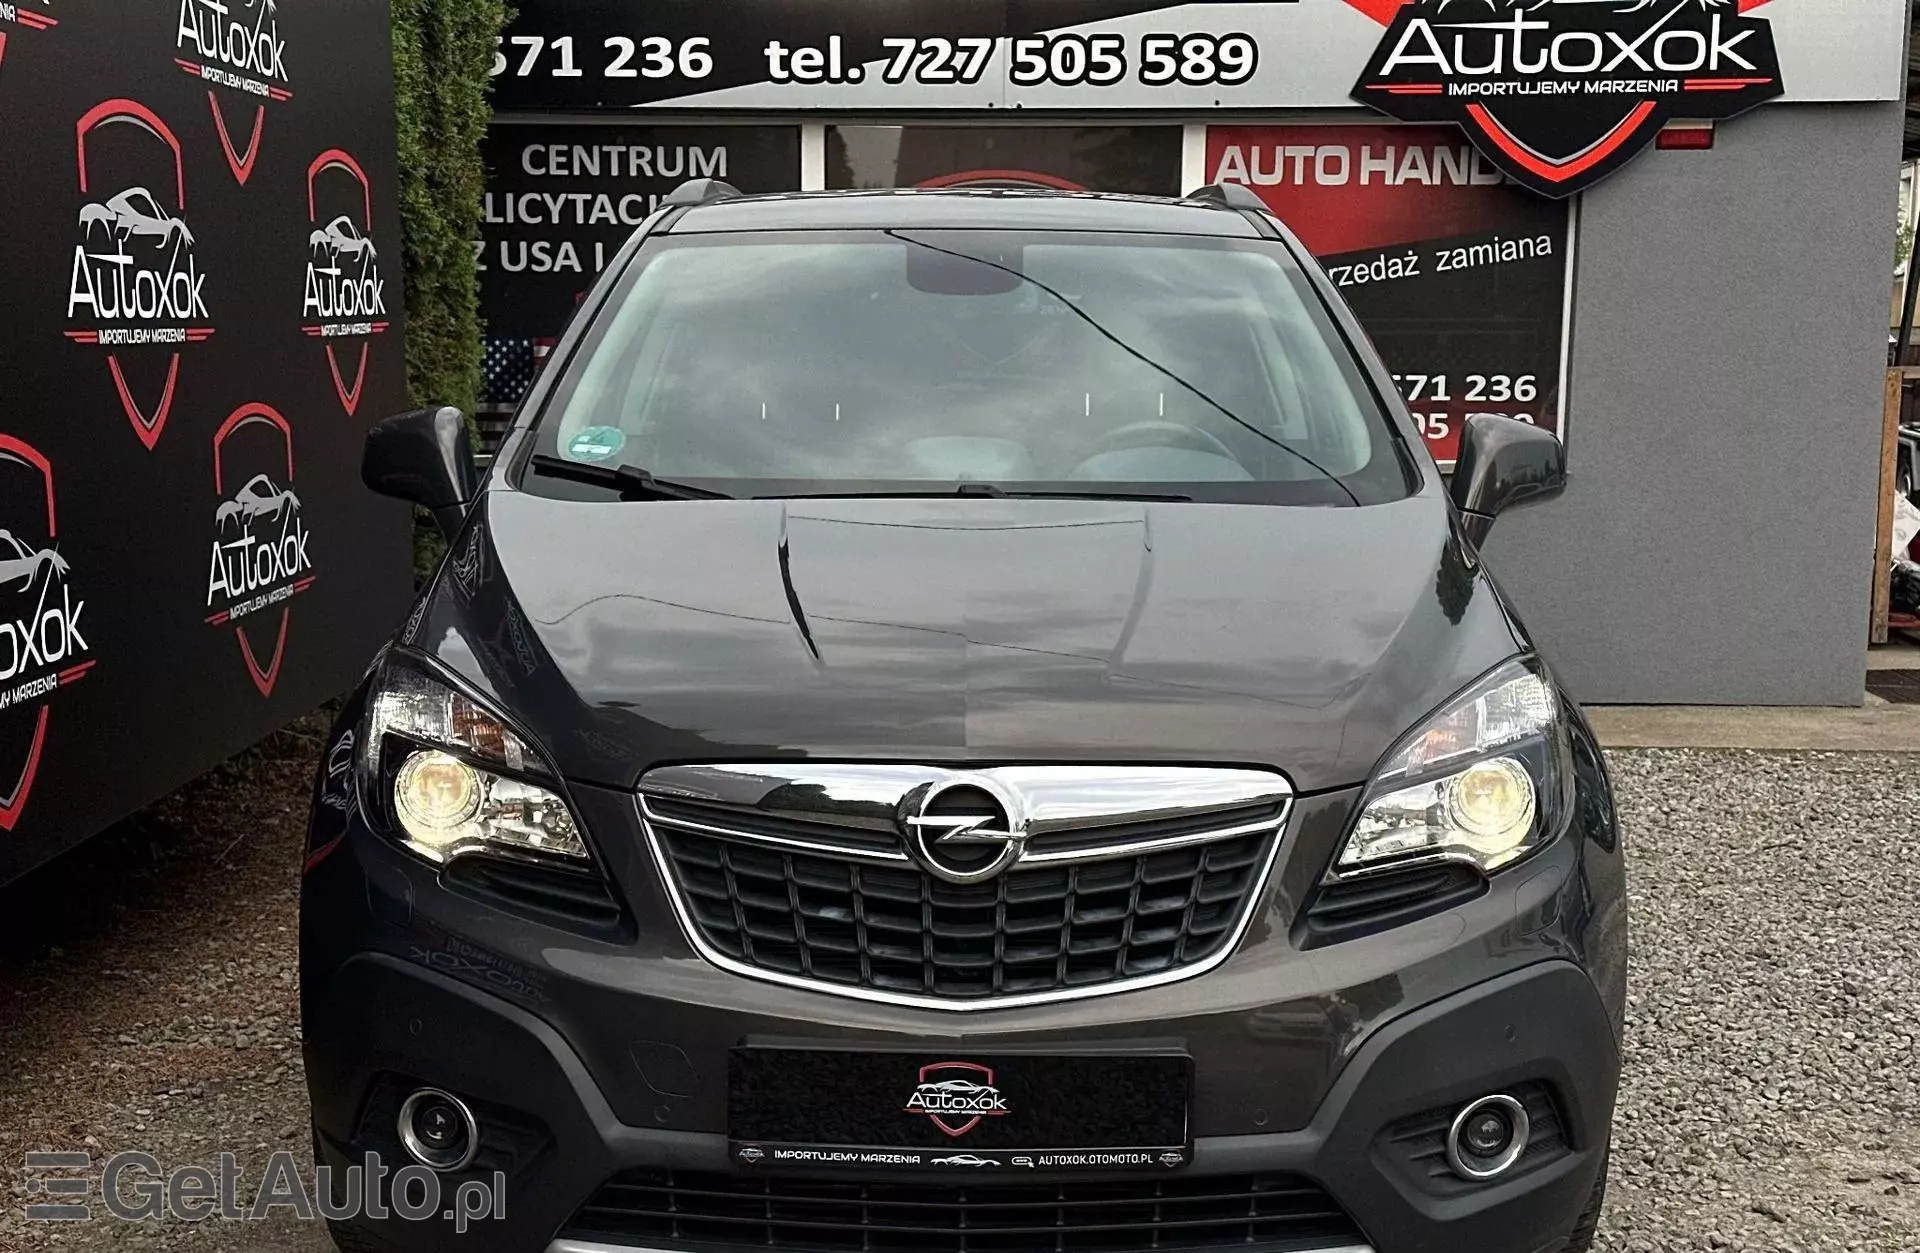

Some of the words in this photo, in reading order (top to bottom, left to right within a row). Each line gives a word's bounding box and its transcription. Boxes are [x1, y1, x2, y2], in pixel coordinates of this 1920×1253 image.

[177, 0, 288, 82] Autoxok
[604, 36, 713, 79] 236
[1379, 4, 1757, 75] Autoxok
[764, 36, 862, 80] tel.
[883, 37, 994, 80] 727
[1014, 38, 1123, 82] 505
[1143, 38, 1253, 82] 589
[1448, 80, 1580, 96] IMPORTUJEMY
[1584, 79, 1678, 94] MARZENIA
[522, 144, 728, 178] CENTRUM
[1214, 145, 1349, 185] AUTO
[1360, 145, 1519, 185] HAND
[501, 241, 583, 273] USA
[1436, 234, 1553, 272] zamiana
[68, 234, 209, 318] Autoxok
[303, 252, 386, 317] Autoxok
[1464, 374, 1537, 403] 236
[207, 512, 312, 606] Autoxok
[12, 673, 57, 704] MARZENIA
[906, 1090, 1008, 1110] Autoxok
[774, 1149, 858, 1162] IMPORTUJEMY
[861, 1153, 921, 1165] MARZENIA
[1038, 1153, 1153, 1166] AUTOXOK.OTOMOTO.PL
